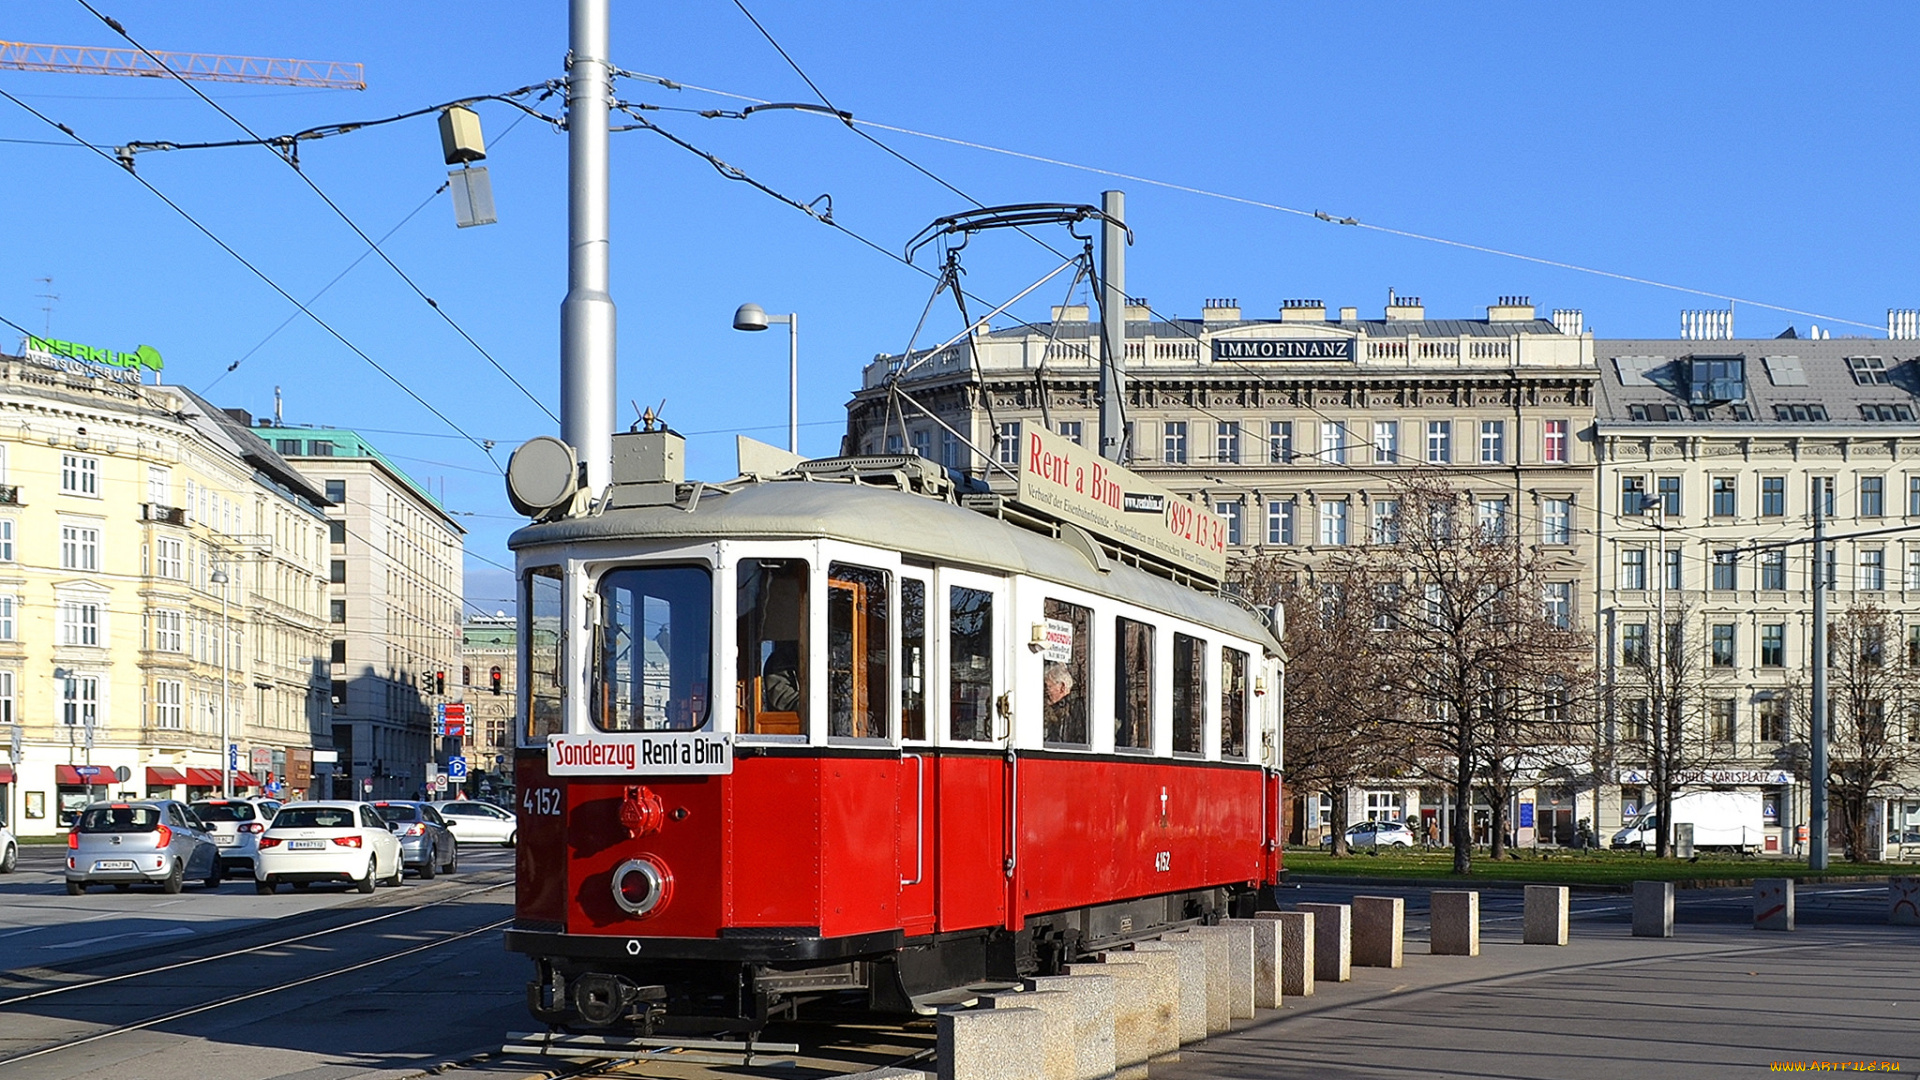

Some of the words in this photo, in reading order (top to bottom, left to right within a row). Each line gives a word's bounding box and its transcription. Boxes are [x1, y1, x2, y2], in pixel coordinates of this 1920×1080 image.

[29, 336, 141, 371] MERKUR
[1220, 342, 1348, 357] IMMOFINANZ
[1029, 432, 1070, 488] Rent
[1075, 466, 1084, 494] a
[1090, 461, 1121, 510] Bim
[1052, 494, 1063, 510] der
[1170, 500, 1193, 540] 892
[1195, 513, 1208, 547] 13
[1210, 520, 1225, 554] 34
[556, 739, 635, 770] Sonderzug
[642, 738, 678, 765] Rent
[681, 743, 691, 764] a
[694, 737, 724, 765] Bim
[1712, 770, 1771, 784] KARLSPLATZ
[523, 788, 561, 815] 4152
[1155, 851, 1171, 872] 4152
